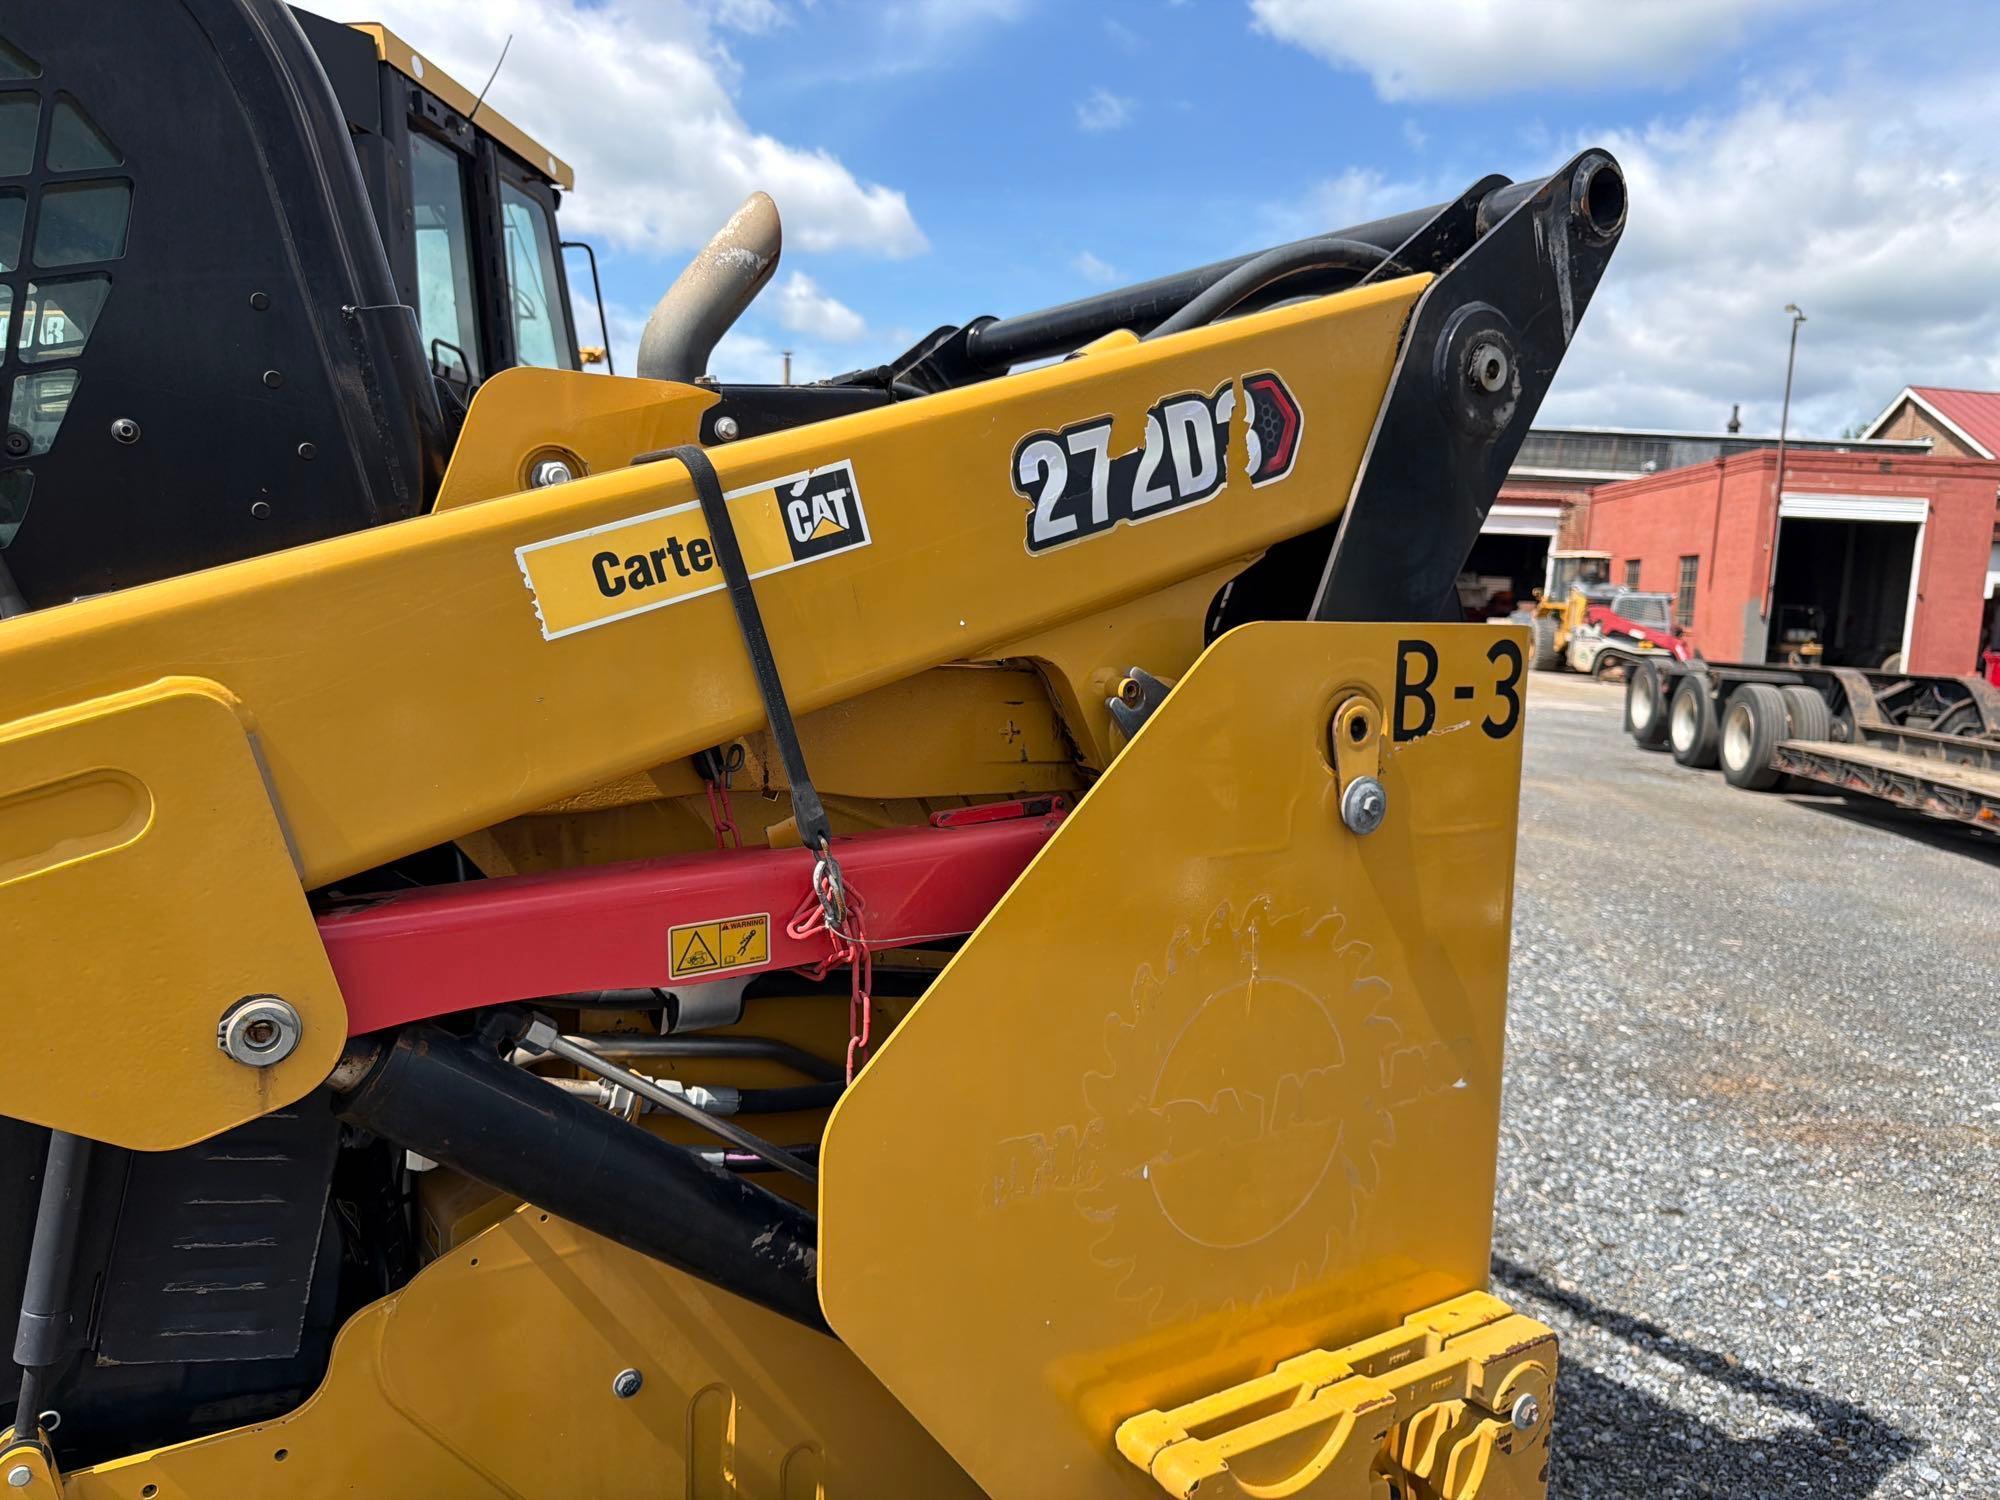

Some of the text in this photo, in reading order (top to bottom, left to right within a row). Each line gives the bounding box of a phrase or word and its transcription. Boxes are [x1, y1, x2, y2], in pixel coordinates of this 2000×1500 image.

[591, 487, 850, 598] Carte CAT
[1393, 639, 1523, 742] B-3
[730, 919, 764, 929] WARNING
